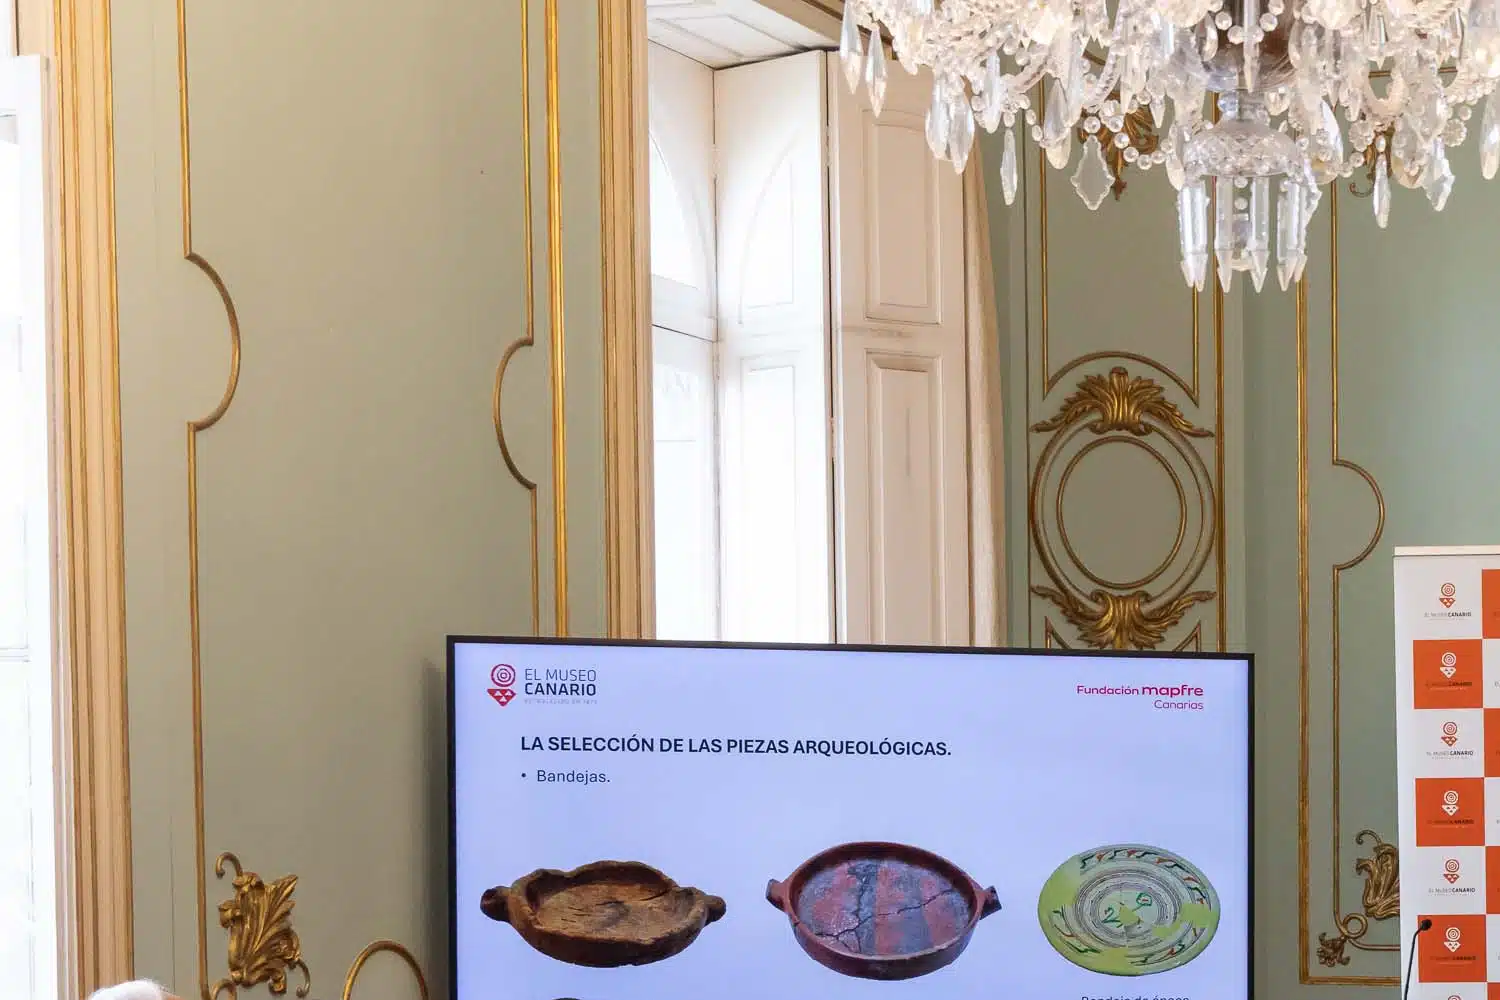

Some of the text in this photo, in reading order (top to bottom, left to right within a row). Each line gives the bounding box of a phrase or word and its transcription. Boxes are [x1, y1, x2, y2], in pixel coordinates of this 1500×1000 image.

[524, 668, 597, 682] EL MUSEO
[524, 682, 597, 696] CANARIO
[1077, 684, 1204, 698] Fundación mapfre
[1154, 700, 1204, 710] Canarias
[520, 733, 952, 756] LA SELECCIÓN DE LAS PIEZAS ARQUEOLÓGICAS.
[536, 769, 611, 785] Bandejas.
